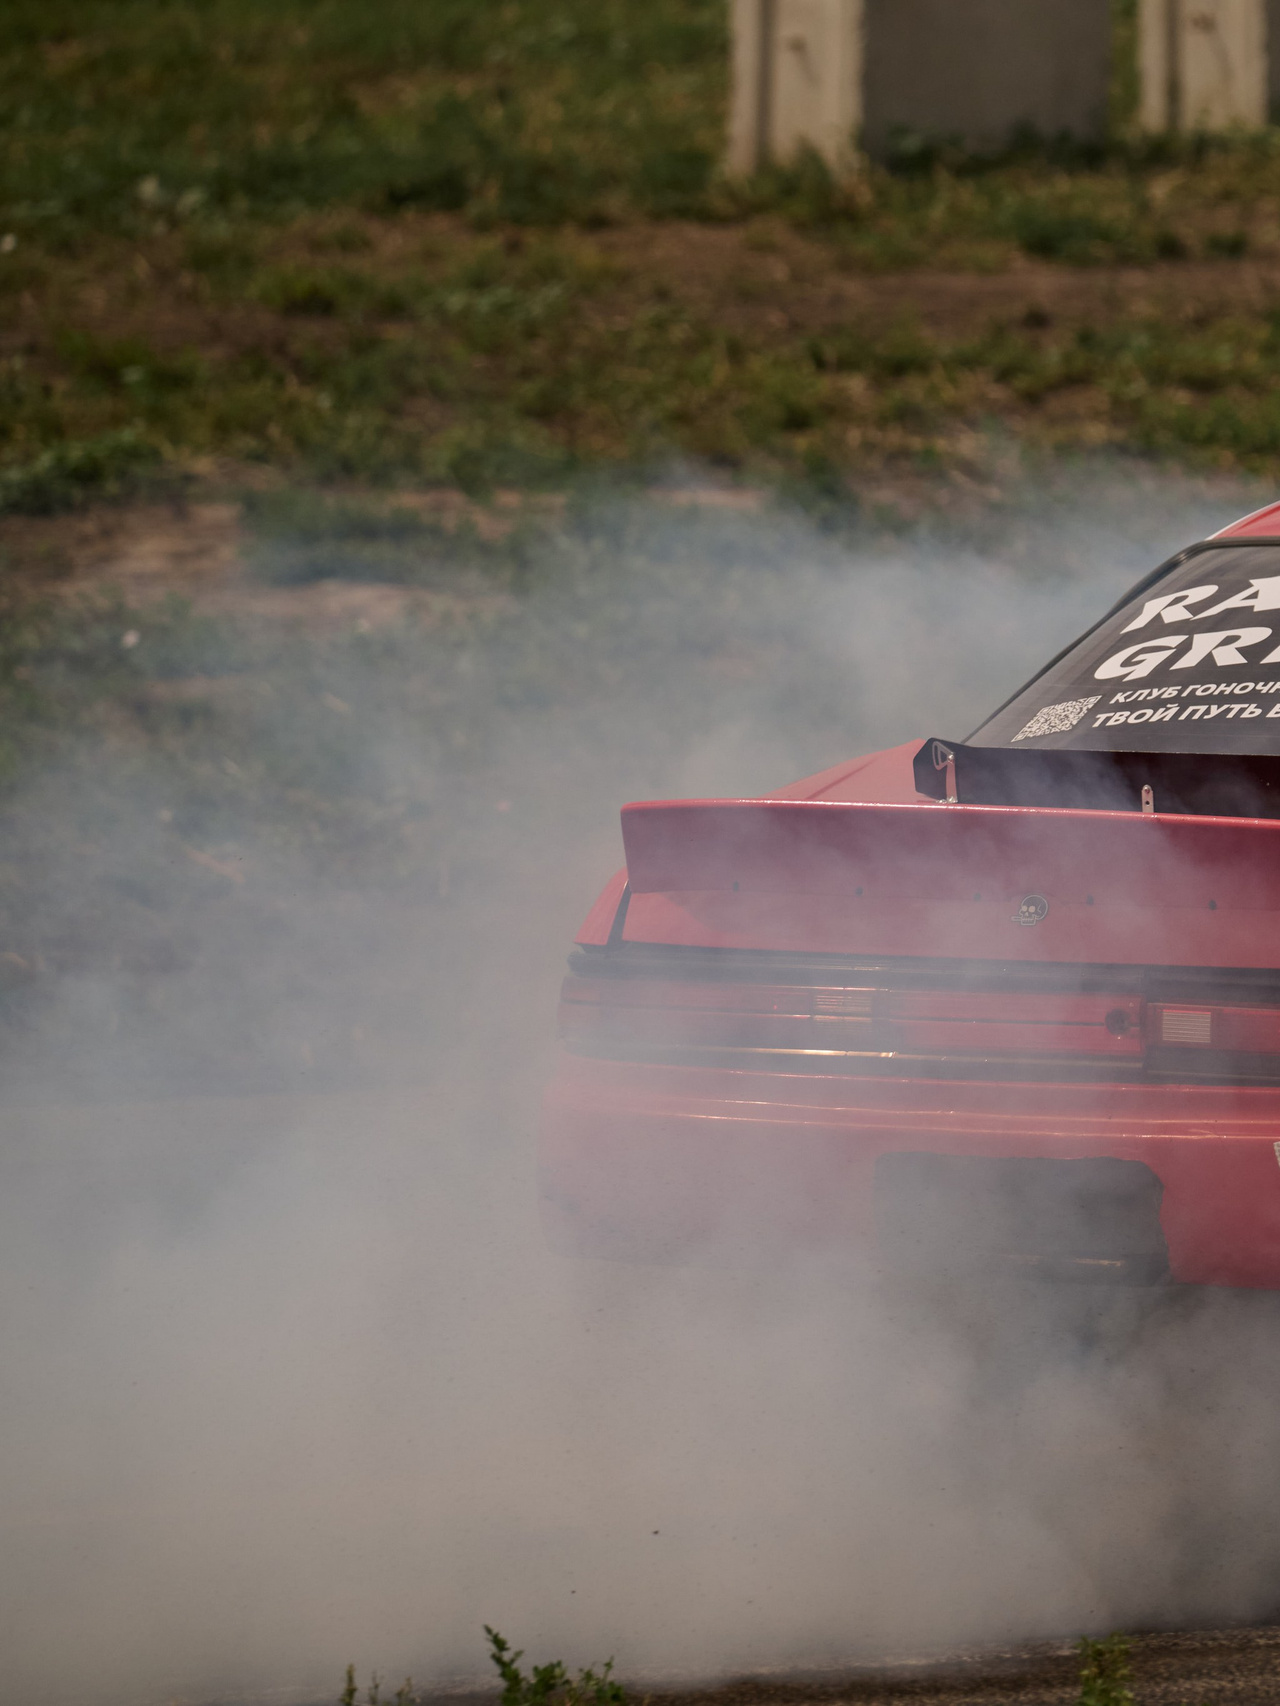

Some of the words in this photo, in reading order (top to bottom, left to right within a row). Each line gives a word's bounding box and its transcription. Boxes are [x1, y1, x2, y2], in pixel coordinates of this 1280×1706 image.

[1109, 684, 1182, 704] КЛУБ
[1092, 702, 1184, 728] ТВОЙ
[1181, 703, 1263, 721] ПУТЬ
